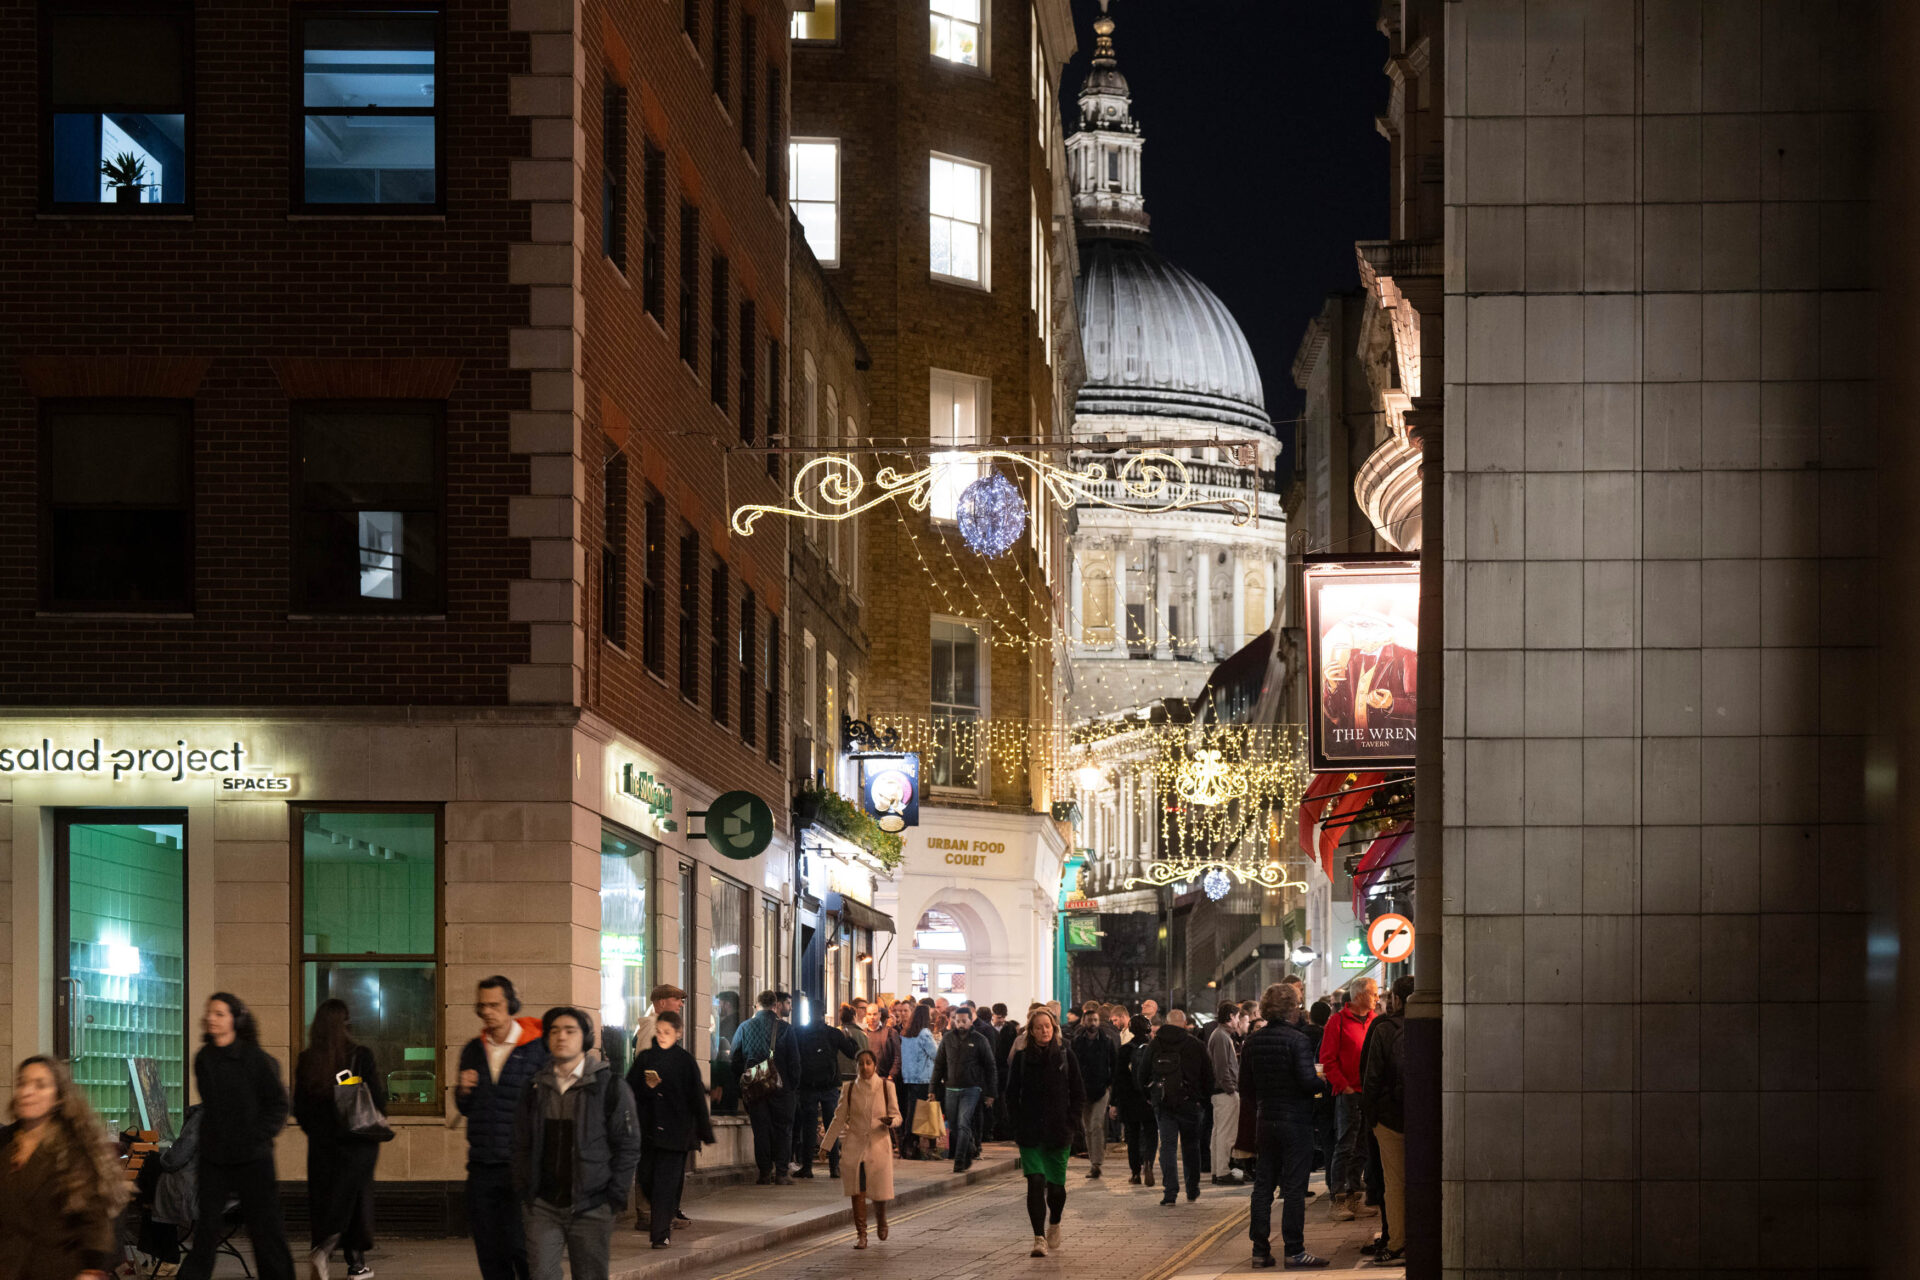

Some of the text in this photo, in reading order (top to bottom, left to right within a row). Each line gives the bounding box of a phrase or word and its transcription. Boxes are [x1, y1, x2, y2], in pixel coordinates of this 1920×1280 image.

[1333, 727, 1417, 743] THE WREN
[1361, 740, 1390, 748] TAVERN
[0, 738, 244, 782] salad project
[222, 777, 288, 790] SPACES
[927, 837, 1005, 854] URBAN FOOD
[945, 853, 987, 866] COURT
